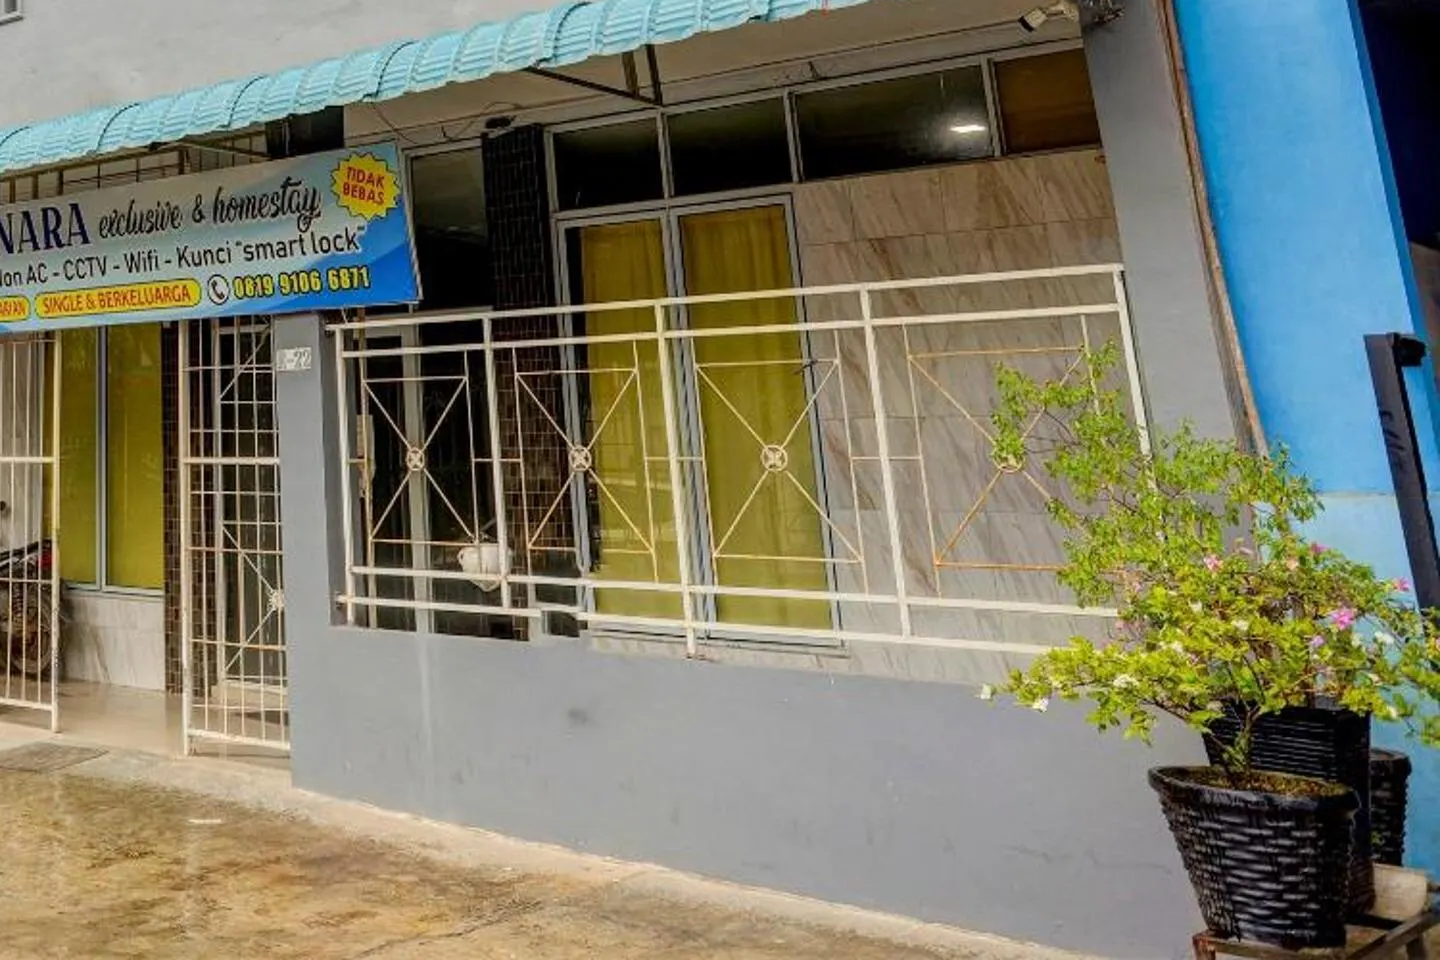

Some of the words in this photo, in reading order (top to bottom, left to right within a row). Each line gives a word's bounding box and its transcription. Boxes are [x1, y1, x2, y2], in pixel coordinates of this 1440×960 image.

[345, 166, 387, 188] TIDAK
[98, 198, 184, 239] exclusive
[191, 193, 206, 224] &
[212, 175, 323, 234] homestay
[342, 182, 386, 205] BEBAS
[26, 262, 48, 284] AC
[62, 255, 108, 281] CCTV
[123, 248, 160, 274] Wifi
[176, 240, 232, 269] Kunci
[232, 274, 274, 300] 0819
[278, 269, 322, 295] 9106
[326, 265, 370, 289] 6871
[42, 295, 83, 314] SINGLE
[86, 292, 97, 311] &
[99, 284, 192, 309] BERKELUARGA
